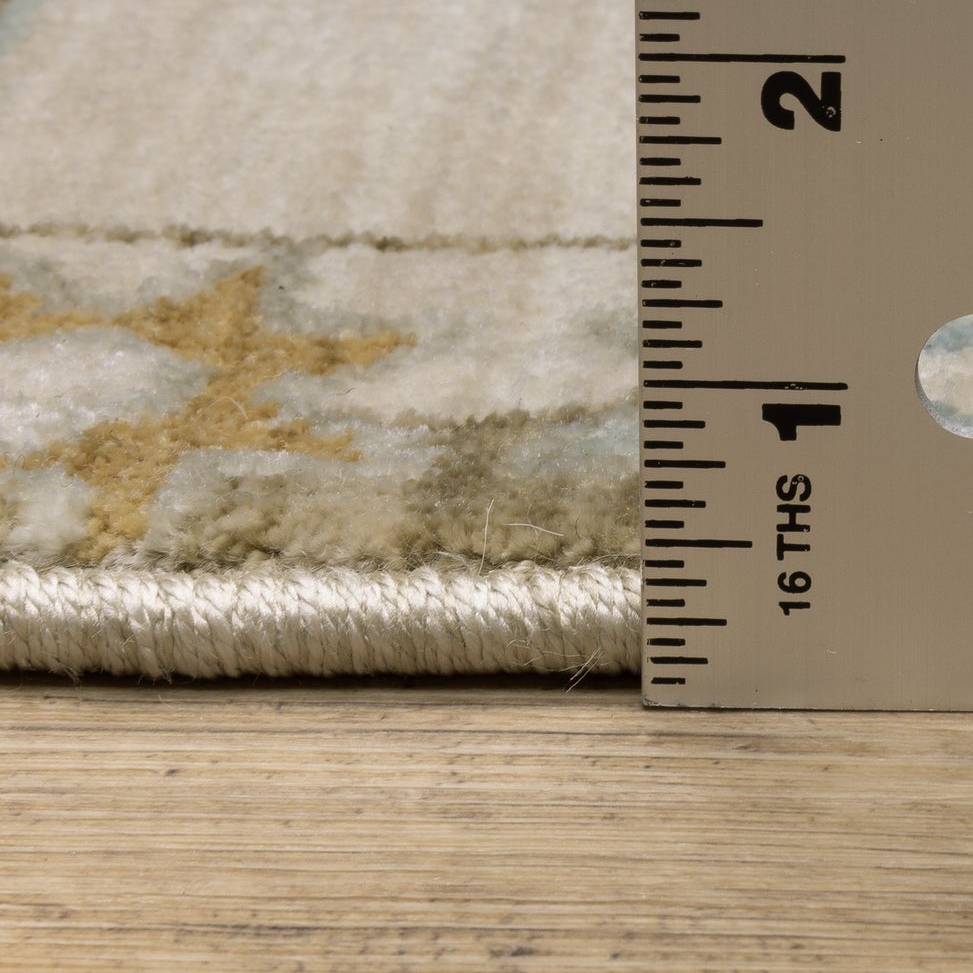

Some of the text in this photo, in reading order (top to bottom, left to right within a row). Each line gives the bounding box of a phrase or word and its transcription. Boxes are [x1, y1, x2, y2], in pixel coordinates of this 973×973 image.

[760, 70, 842, 133] 2
[761, 402, 842, 442] 1
[775, 473, 812, 616] 16 THS
